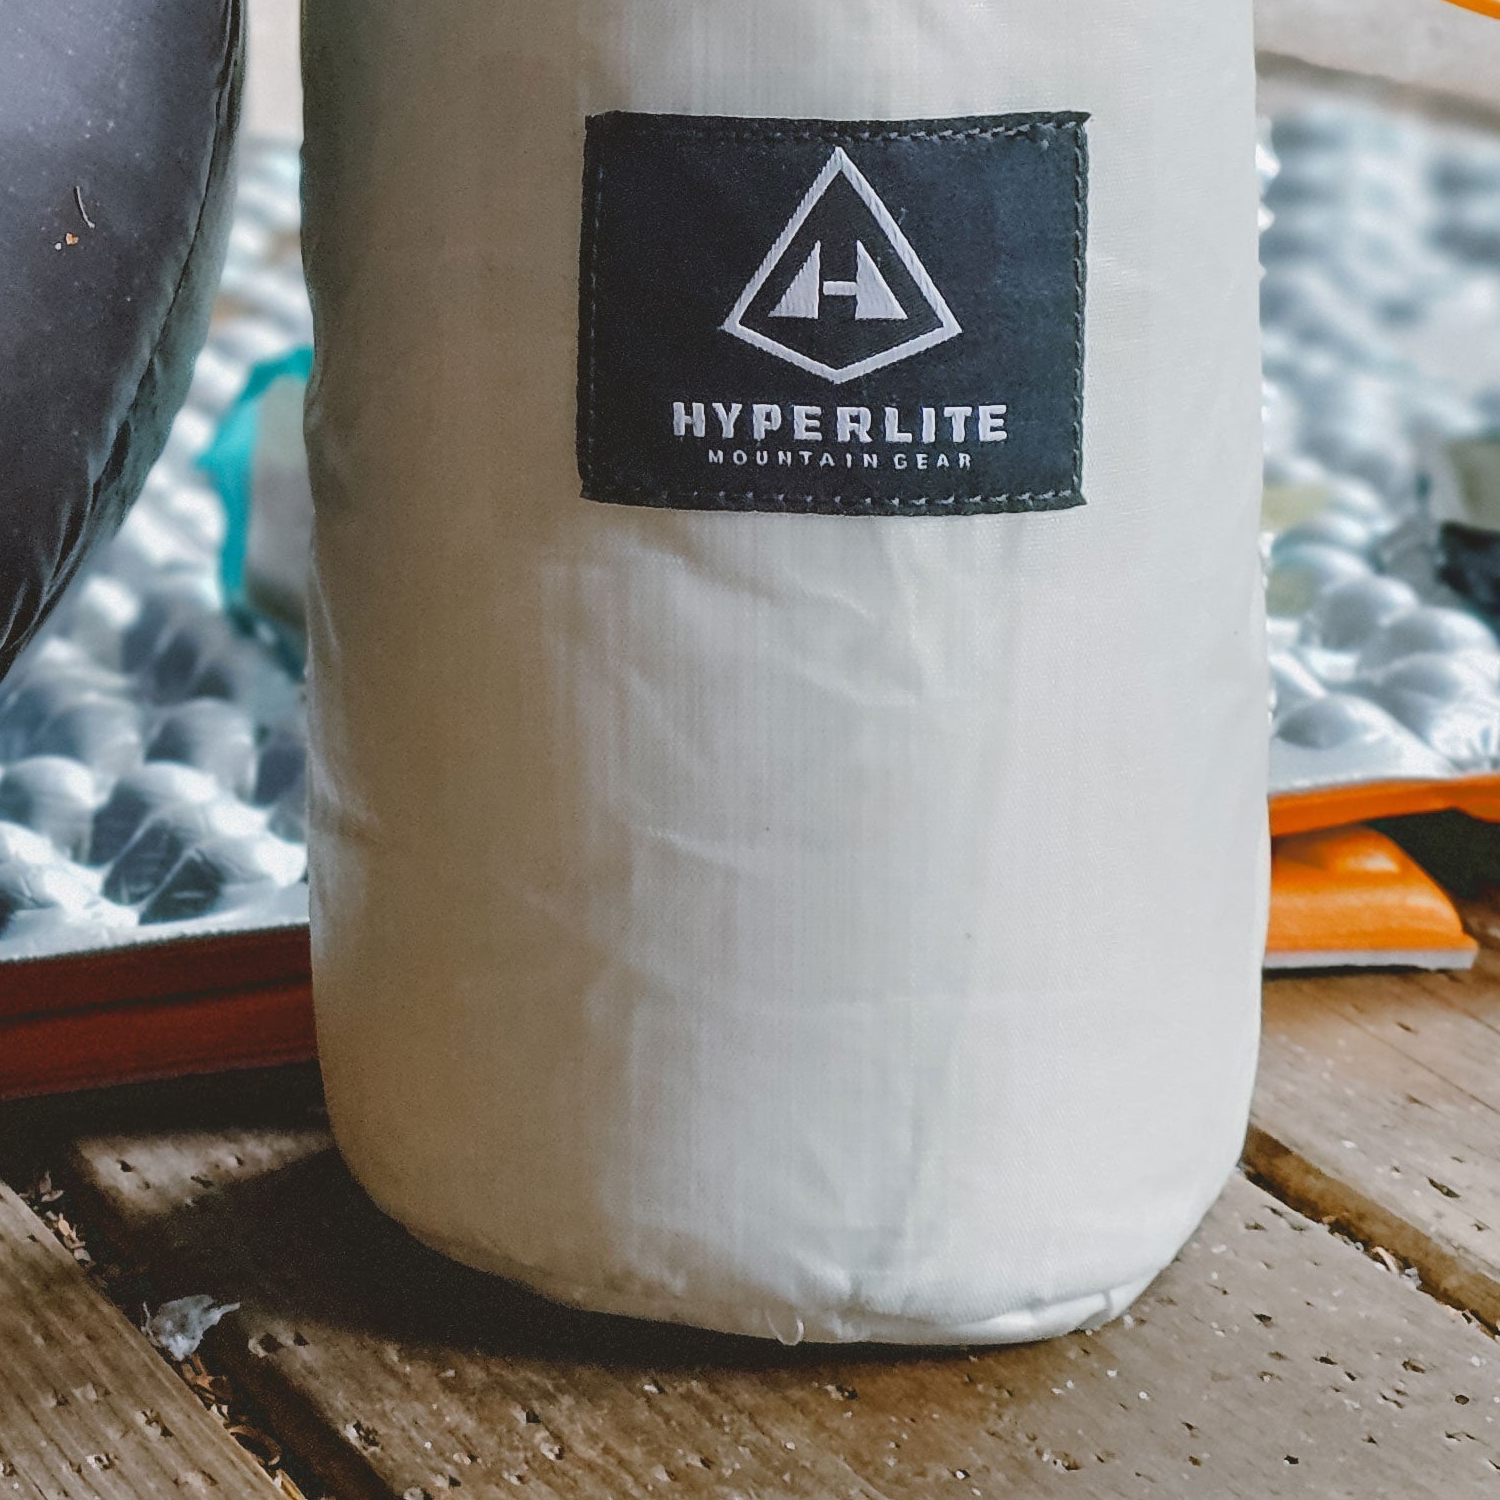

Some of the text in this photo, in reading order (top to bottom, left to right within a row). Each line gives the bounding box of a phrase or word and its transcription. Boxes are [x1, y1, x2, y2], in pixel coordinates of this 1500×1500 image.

[671, 401, 1008, 443] HYPERLITE
[708, 450, 972, 470] MOUNTAIN GEAR
